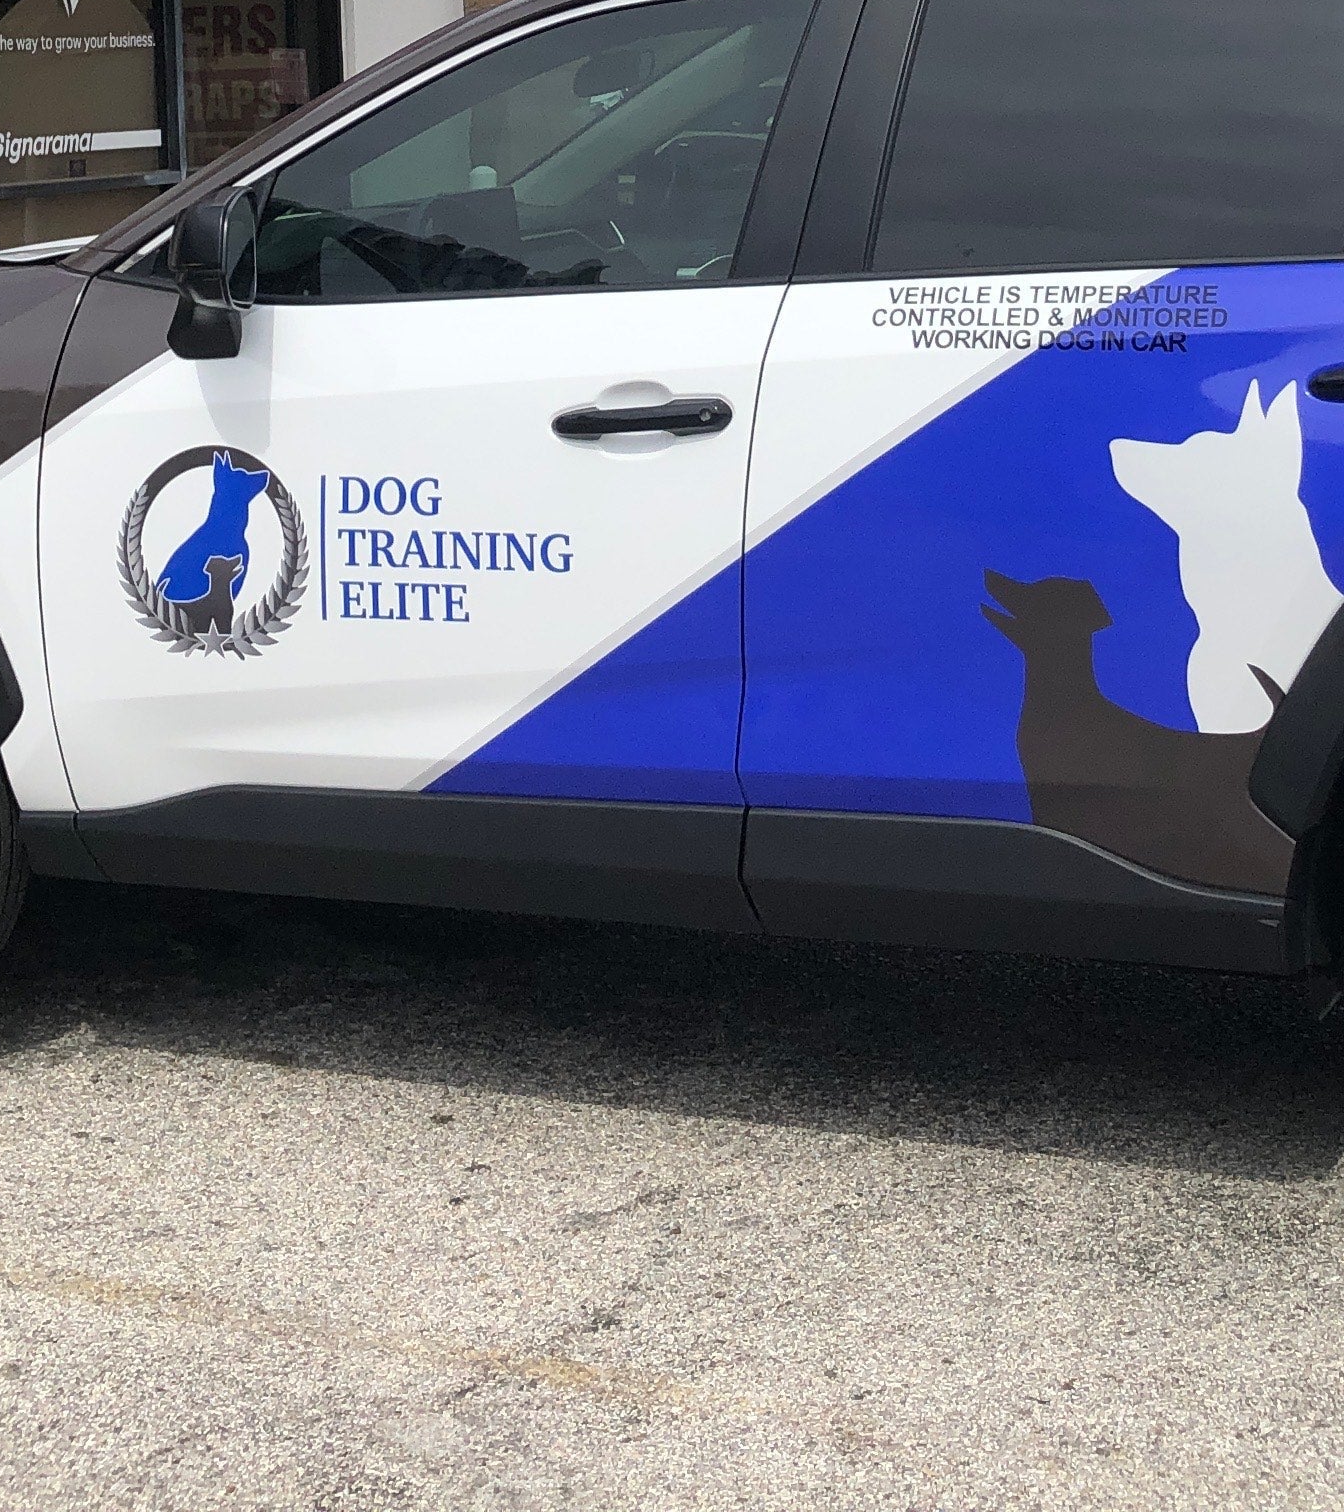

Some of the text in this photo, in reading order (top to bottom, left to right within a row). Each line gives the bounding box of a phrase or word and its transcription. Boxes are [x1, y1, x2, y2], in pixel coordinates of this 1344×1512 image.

[18, 37, 38, 54] way
[40, 35, 52, 51] to
[55, 36, 82, 54] grow
[84, 35, 107, 54] your
[110, 31, 156, 49] business.
[889, 285, 1219, 304] VEHICLE IS TEMPERATURE
[872, 307, 1228, 327] CONTROLLED & MONITORED
[911, 329, 1187, 352] WORKING DOG IN CAR
[338, 476, 443, 516] DOG
[337, 528, 574, 573] TRAINING
[338, 580, 470, 623] ELITE
